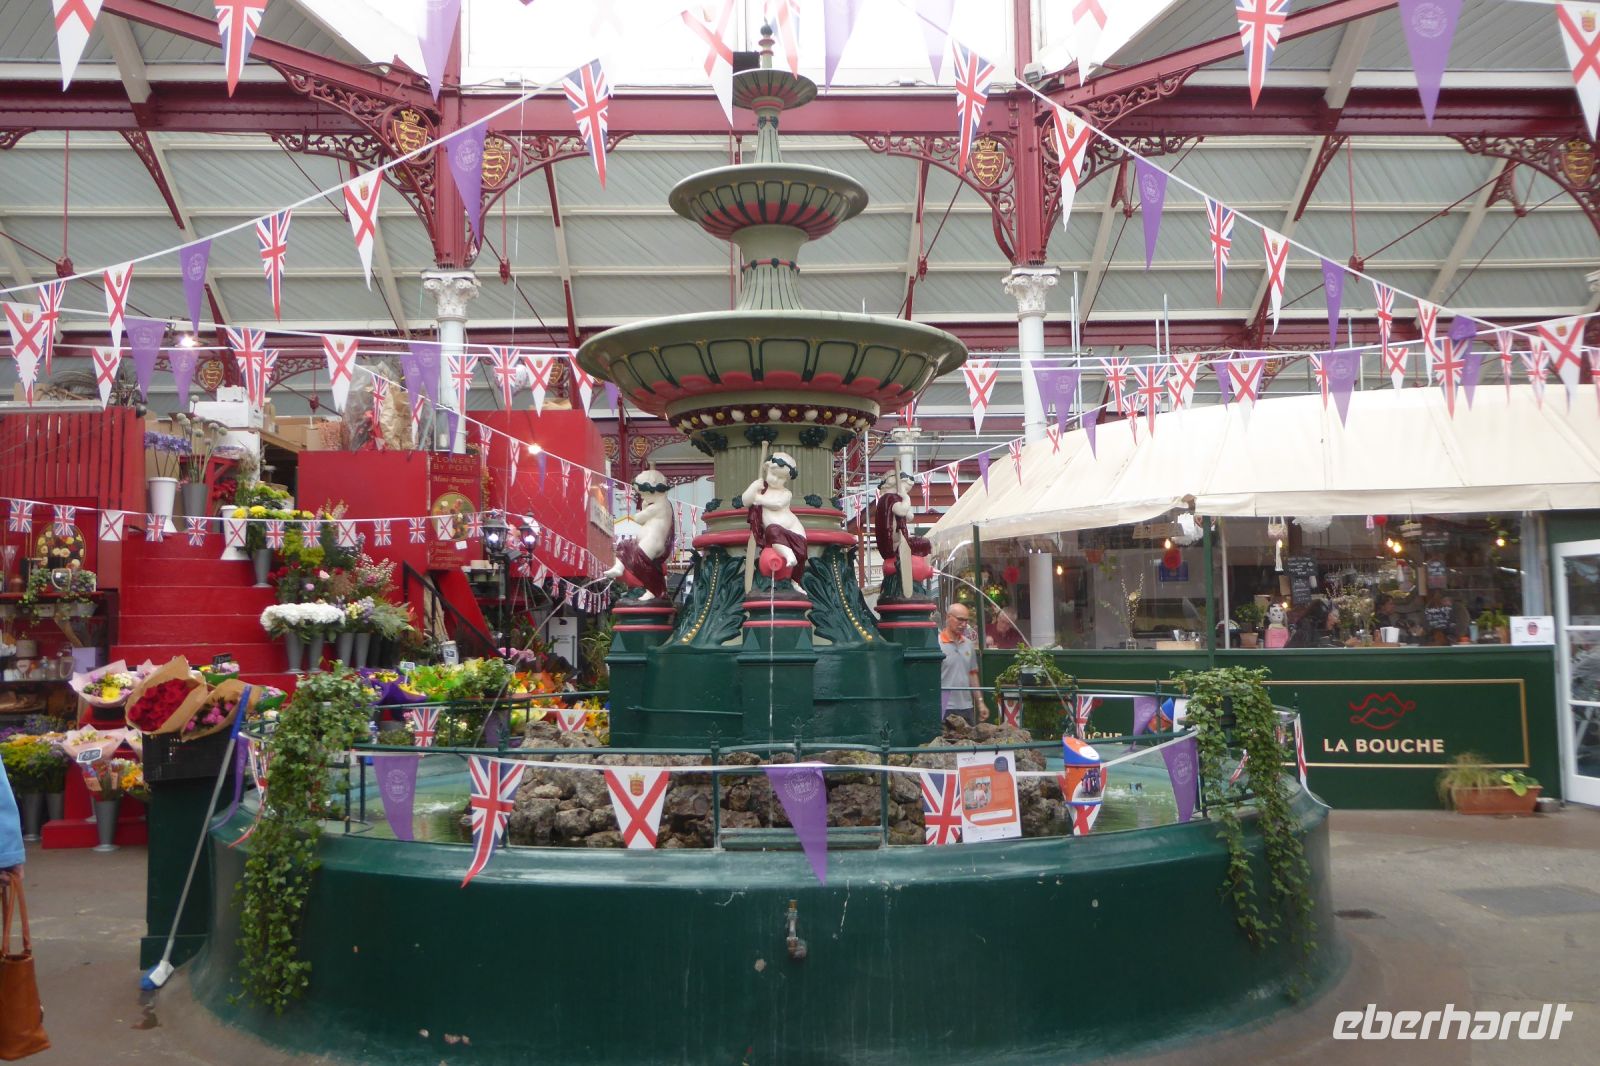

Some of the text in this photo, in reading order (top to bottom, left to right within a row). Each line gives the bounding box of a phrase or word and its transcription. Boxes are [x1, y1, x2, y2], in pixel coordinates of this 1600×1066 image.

[430, 455, 477, 465] FLOWERS
[448, 464, 474, 472] POST
[1323, 738, 1445, 753] LA BOUCHE
